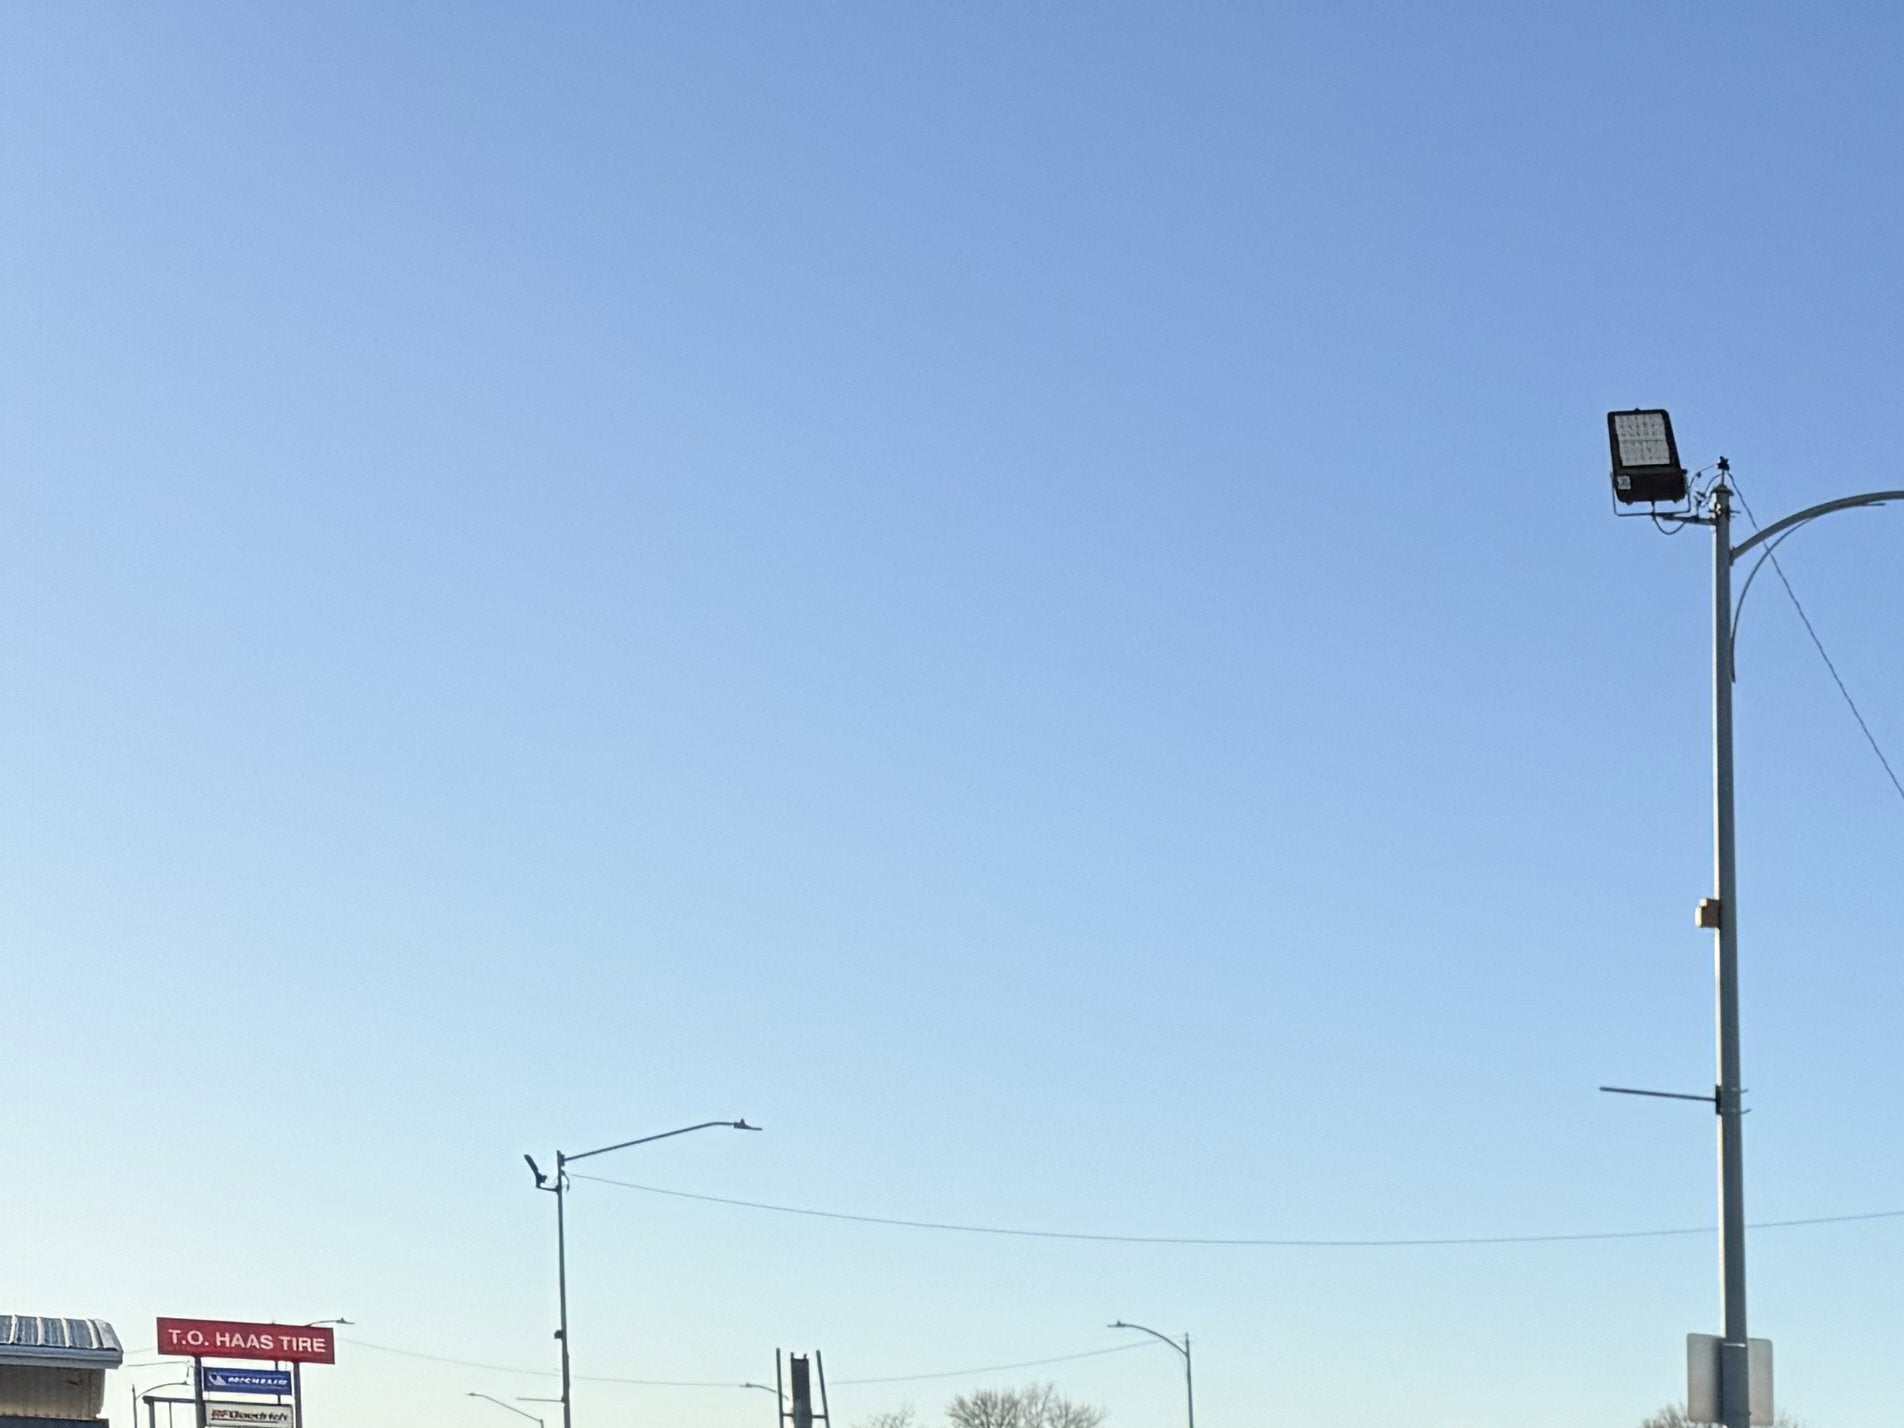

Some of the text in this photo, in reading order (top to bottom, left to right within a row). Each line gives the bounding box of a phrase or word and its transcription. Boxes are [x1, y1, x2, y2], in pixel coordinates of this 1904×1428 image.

[168, 1329, 327, 1352] T.O. HAAS TIRE
